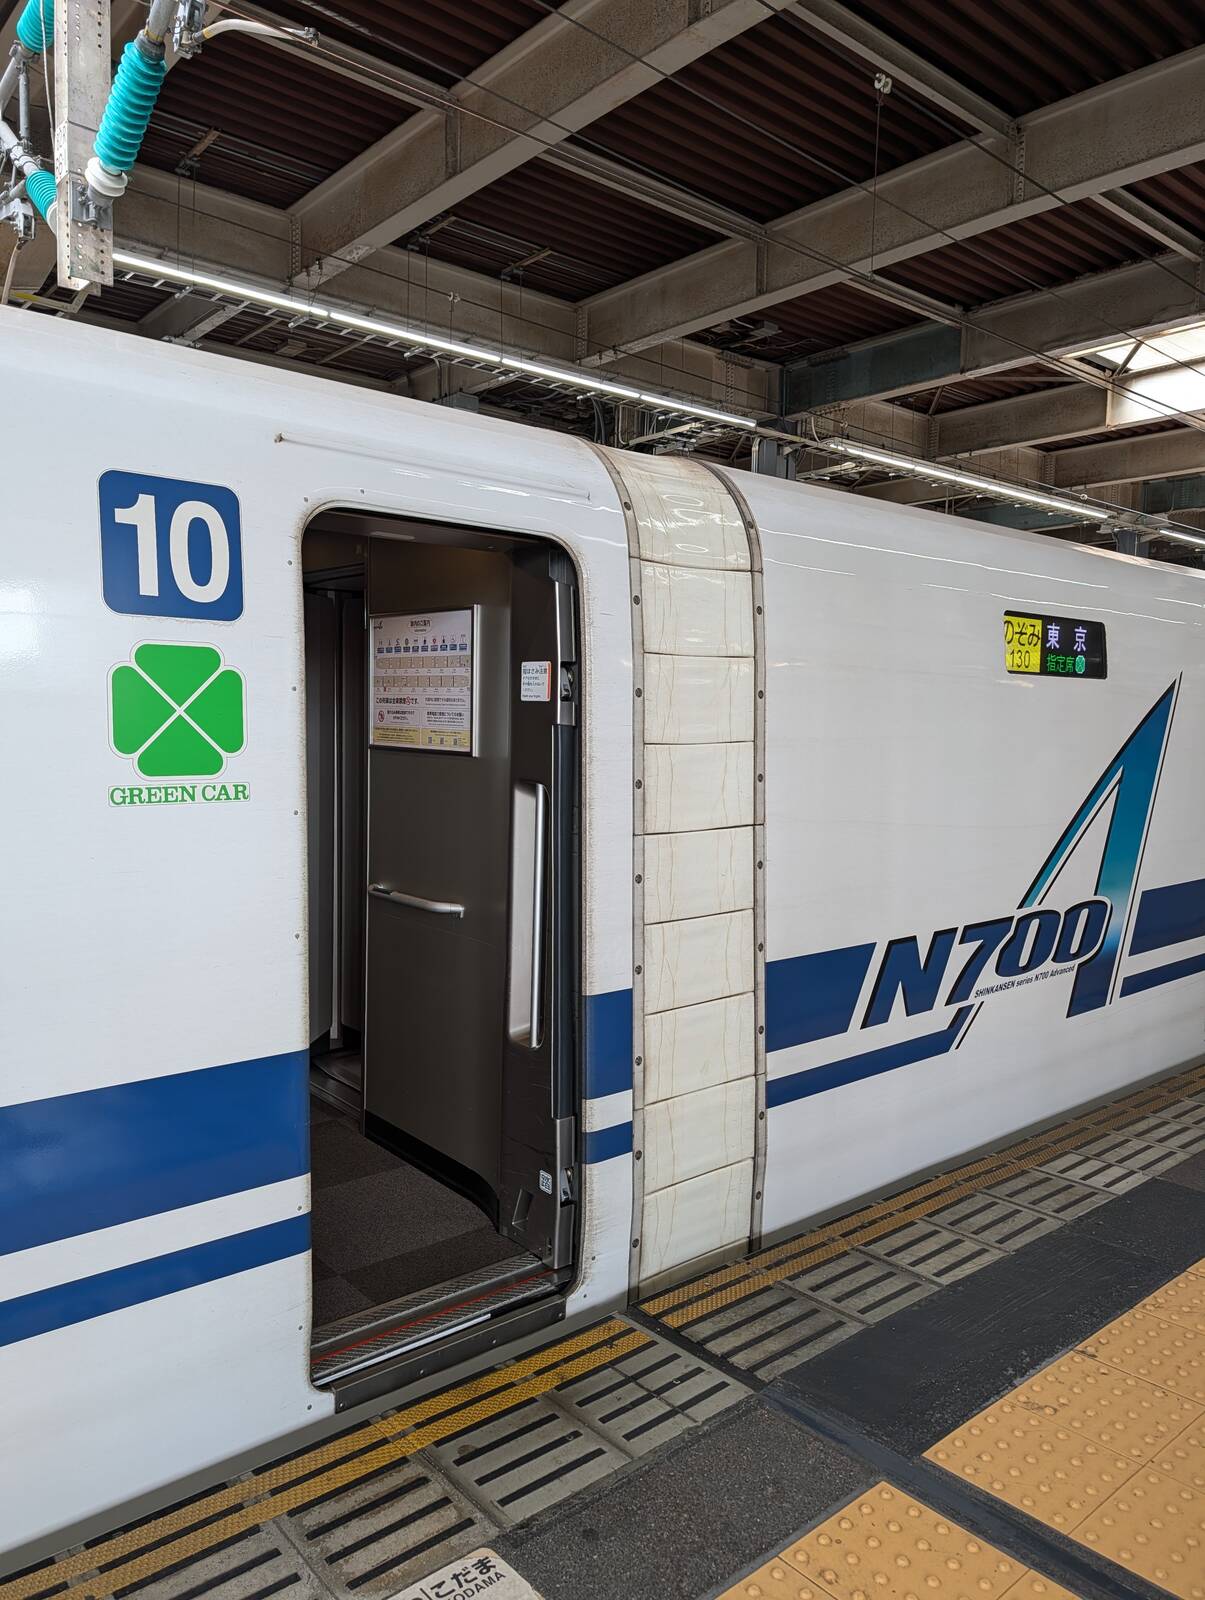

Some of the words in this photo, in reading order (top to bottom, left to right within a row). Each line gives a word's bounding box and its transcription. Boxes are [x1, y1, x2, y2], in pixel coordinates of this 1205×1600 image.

[114, 493, 229, 603] 10
[1004, 620, 1041, 647] のぞみ
[1046, 622, 1087, 652] 東京
[1010, 649, 1030, 668] 130
[1046, 653, 1075, 672] 指定席
[110, 785, 197, 805] GREEN
[202, 783, 249, 801] CAR
[974, 980, 1015, 998] SHINKANSEN
[1016, 976, 1033, 987] series
[1033, 970, 1048, 982] N700
[1049, 963, 1076, 978] Advanced
[430, 1556, 496, 1598] こだま
[448, 1571, 507, 1600] ODAMA
